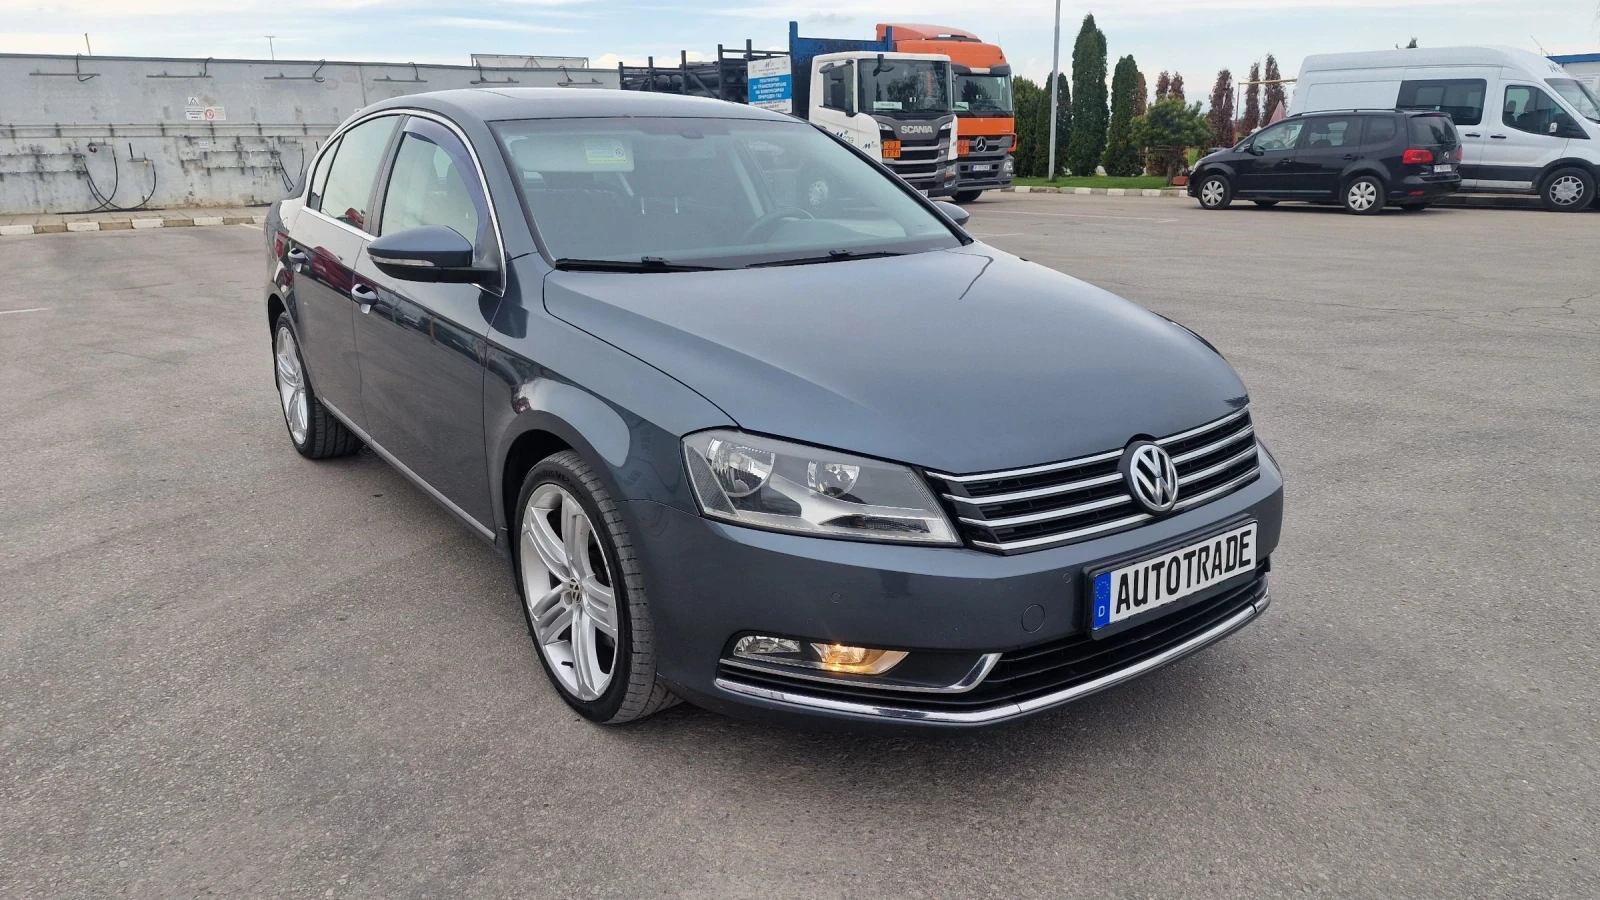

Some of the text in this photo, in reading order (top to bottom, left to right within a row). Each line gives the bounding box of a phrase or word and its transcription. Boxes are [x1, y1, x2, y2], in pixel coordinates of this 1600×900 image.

[901, 125, 933, 134] SCANIA
[1115, 529, 1252, 615] AUTOTRADE
[1098, 605, 1105, 617] D
